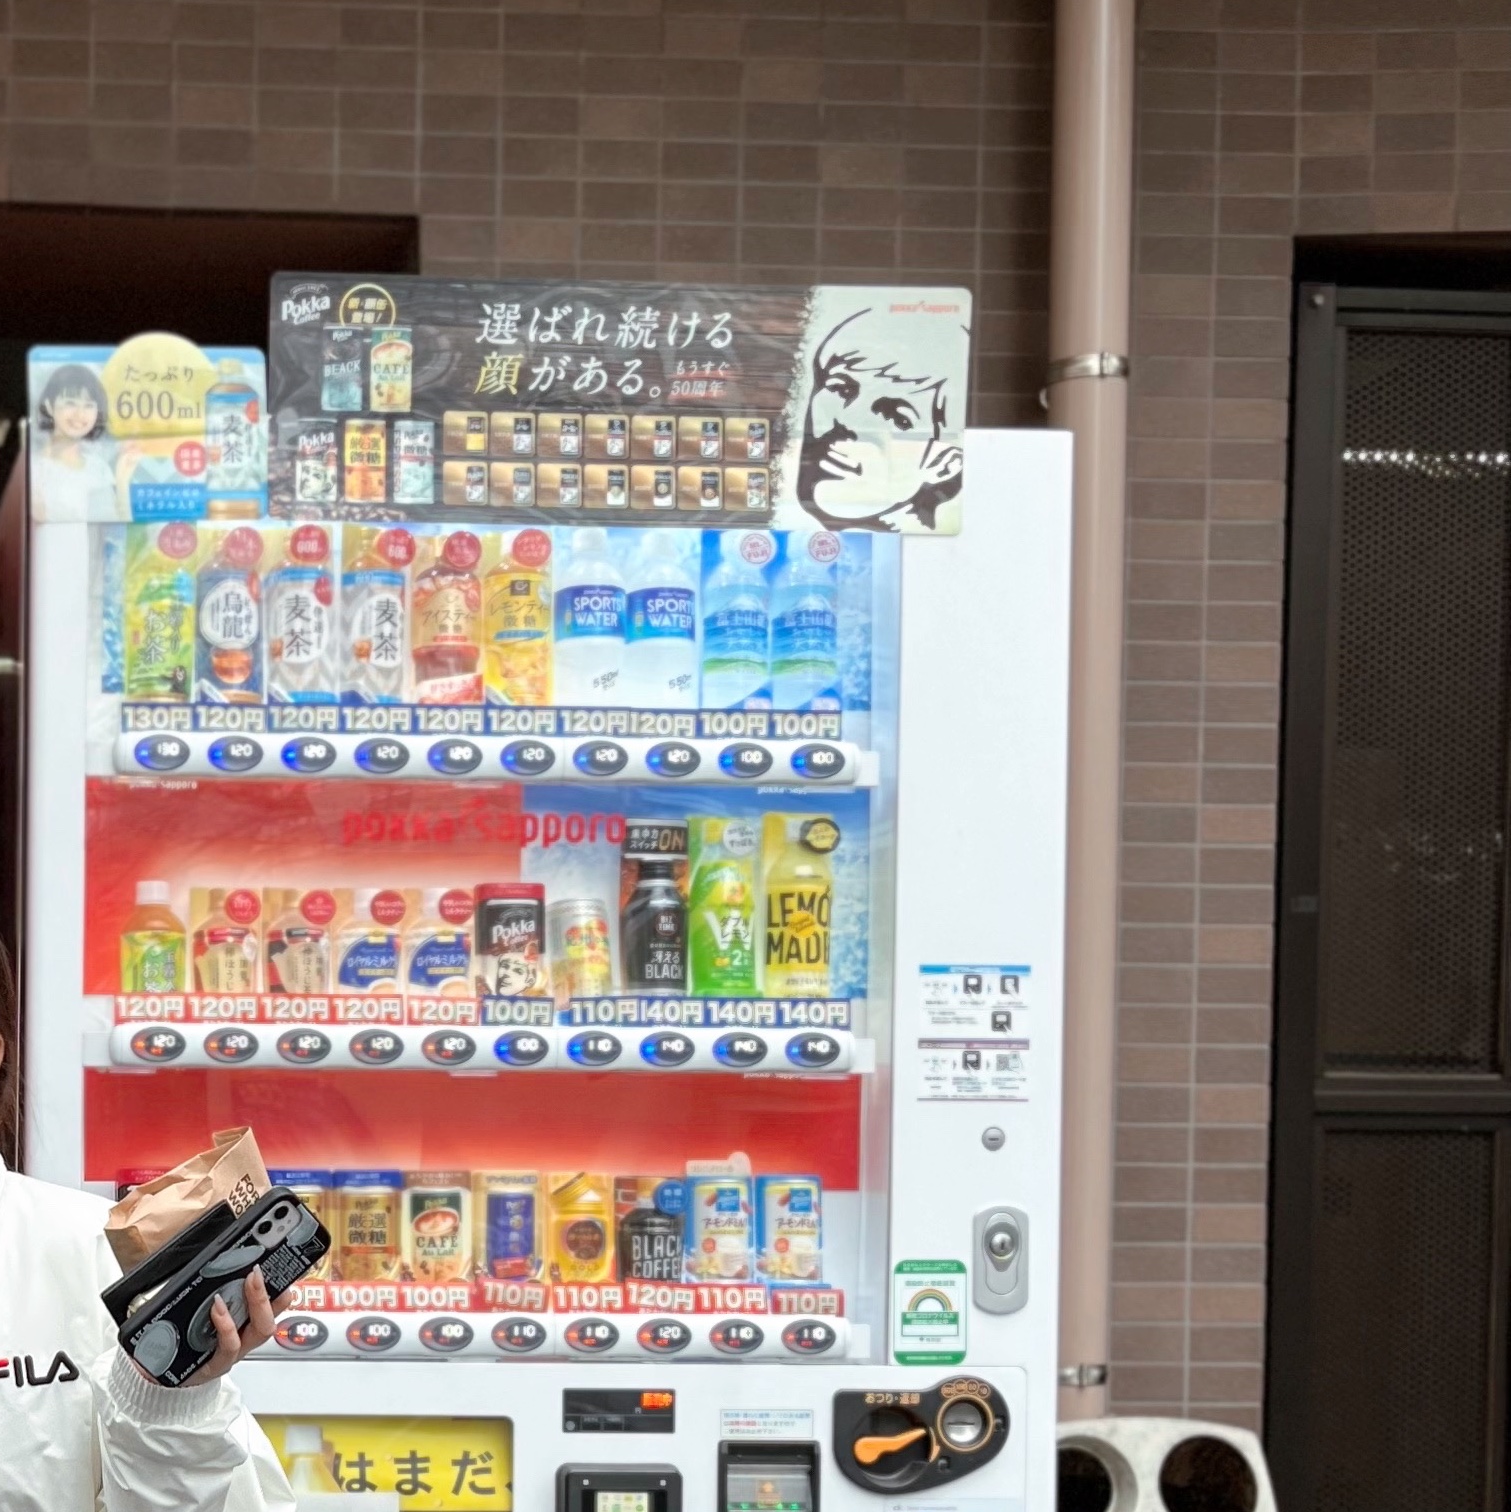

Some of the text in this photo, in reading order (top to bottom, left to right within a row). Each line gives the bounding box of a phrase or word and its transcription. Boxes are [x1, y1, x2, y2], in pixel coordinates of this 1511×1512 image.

[281, 295, 331, 321] Pokka
[475, 303, 733, 349] 選ばれ続ける
[125, 365, 194, 382] たっぷり
[473, 354, 662, 399] 顔がある。
[677, 360, 730, 376] もうすぐ
[671, 380, 725, 397] 50周年
[117, 390, 202, 420] 600ml
[223, 415, 243, 463] 麦茶
[574, 597, 623, 611] SPORTS
[284, 593, 313, 657] 麦茶
[374, 597, 398, 661] 麦茶
[575, 613, 618, 627] WATER
[648, 613, 693, 628] WATER
[123, 706, 191, 730] 130円
[196, 706, 264, 731] 120円
[269, 707, 337, 731] 120円
[343, 707, 411, 732] 120円
[416, 709, 483, 733] 120円
[488, 711, 557, 734] 120円
[562, 711, 629, 734] 120円
[630, 712, 696, 736] 120円
[700, 712, 769, 736] 100円
[772, 713, 841, 737] 100円
[343, 811, 626, 848] pokka sapporo
[659, 829, 685, 851] ON
[492, 920, 536, 943] Pokka
[650, 950, 680, 963] 冴える
[117, 997, 185, 1020] 120円
[189, 997, 257, 1020] 120円
[261, 998, 329, 1021] 120円
[333, 998, 401, 1021] 120円
[410, 1000, 478, 1022] 120円
[483, 999, 553, 1024] 100円
[571, 1000, 639, 1025] 110円
[640, 1000, 702, 1025] 140円
[708, 1001, 776, 1025] 140円
[779, 1001, 848, 1026] 140円
[348, 1213, 387, 1230] 厳選
[348, 1230, 387, 1244] 微糖
[330, 1286, 397, 1309] 100円
[402, 1286, 470, 1309] 100円
[483, 1284, 546, 1309] 110円
[554, 1285, 623, 1310] 110円
[628, 1284, 694, 1311] 120円
[697, 1286, 767, 1310] 110円
[778, 1291, 838, 1315] 110円
